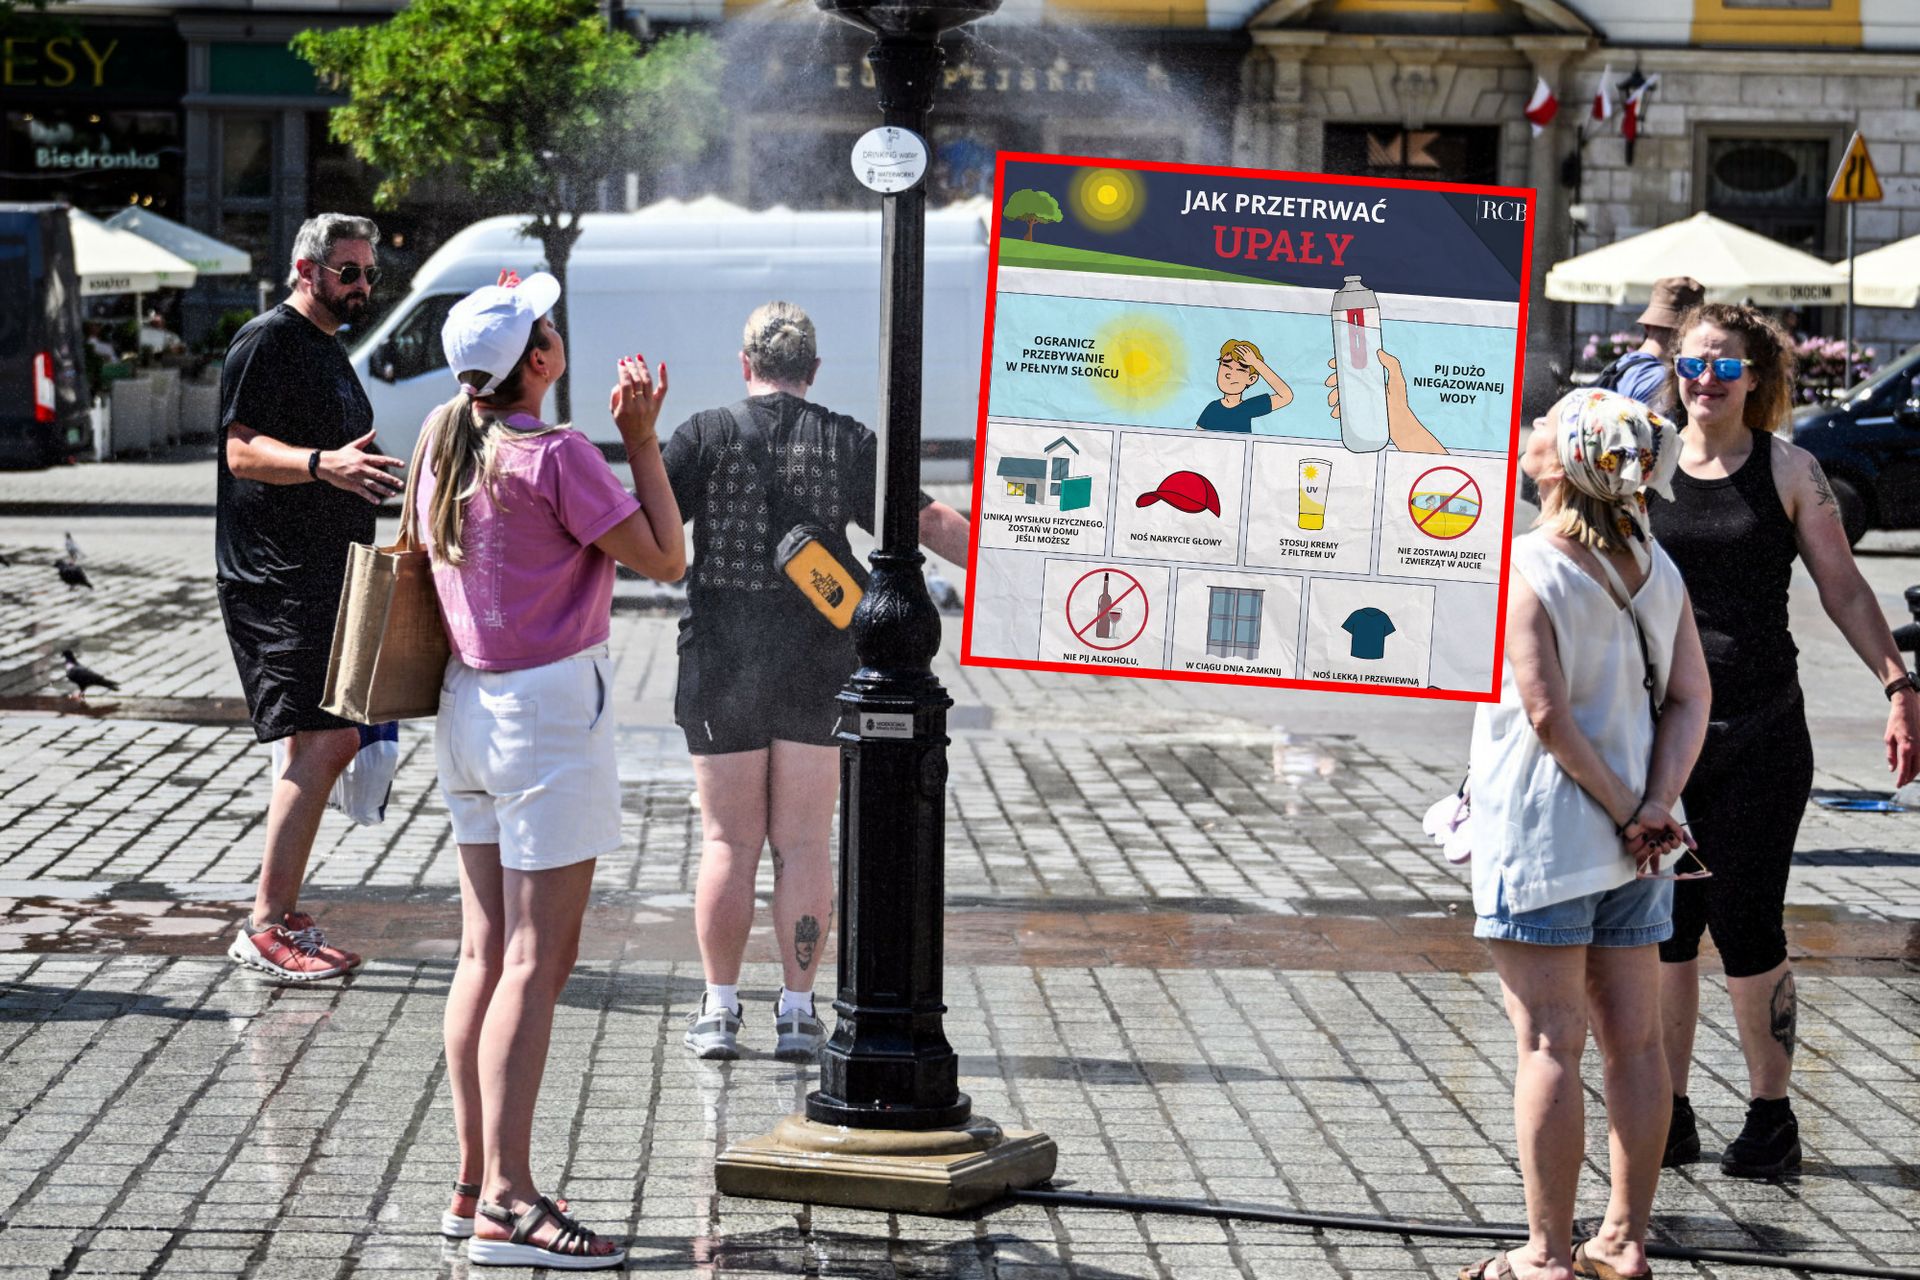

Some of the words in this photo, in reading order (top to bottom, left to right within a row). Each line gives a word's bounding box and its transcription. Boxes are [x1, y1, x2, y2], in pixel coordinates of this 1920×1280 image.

[4, 38, 118, 87] ESY
[834, 62, 1097, 92] EUPEJSKA
[36, 147, 159, 169] Biedronka
[862, 151, 897, 159] DRINKING
[1790, 285, 1832, 299] OKOCIM
